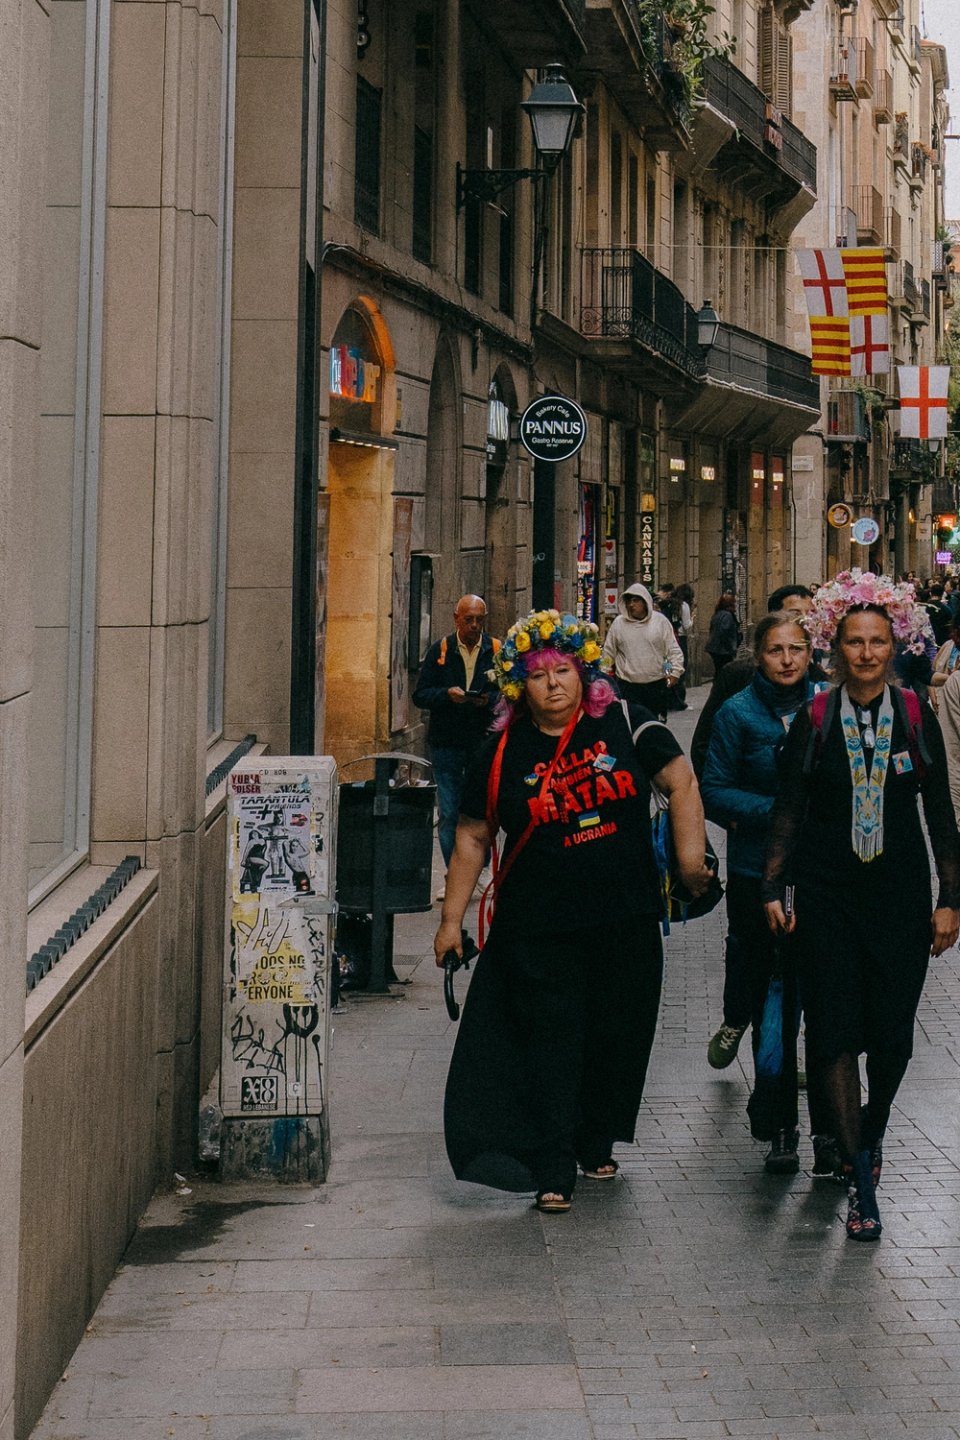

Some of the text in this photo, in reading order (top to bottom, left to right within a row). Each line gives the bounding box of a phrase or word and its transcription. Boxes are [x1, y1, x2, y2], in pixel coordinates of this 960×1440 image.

[525, 420, 581, 435] PANNUS
[642, 515, 652, 582] CANNABIS
[527, 770, 637, 826] MATAR
[564, 821, 618, 847] A UCRANIA
